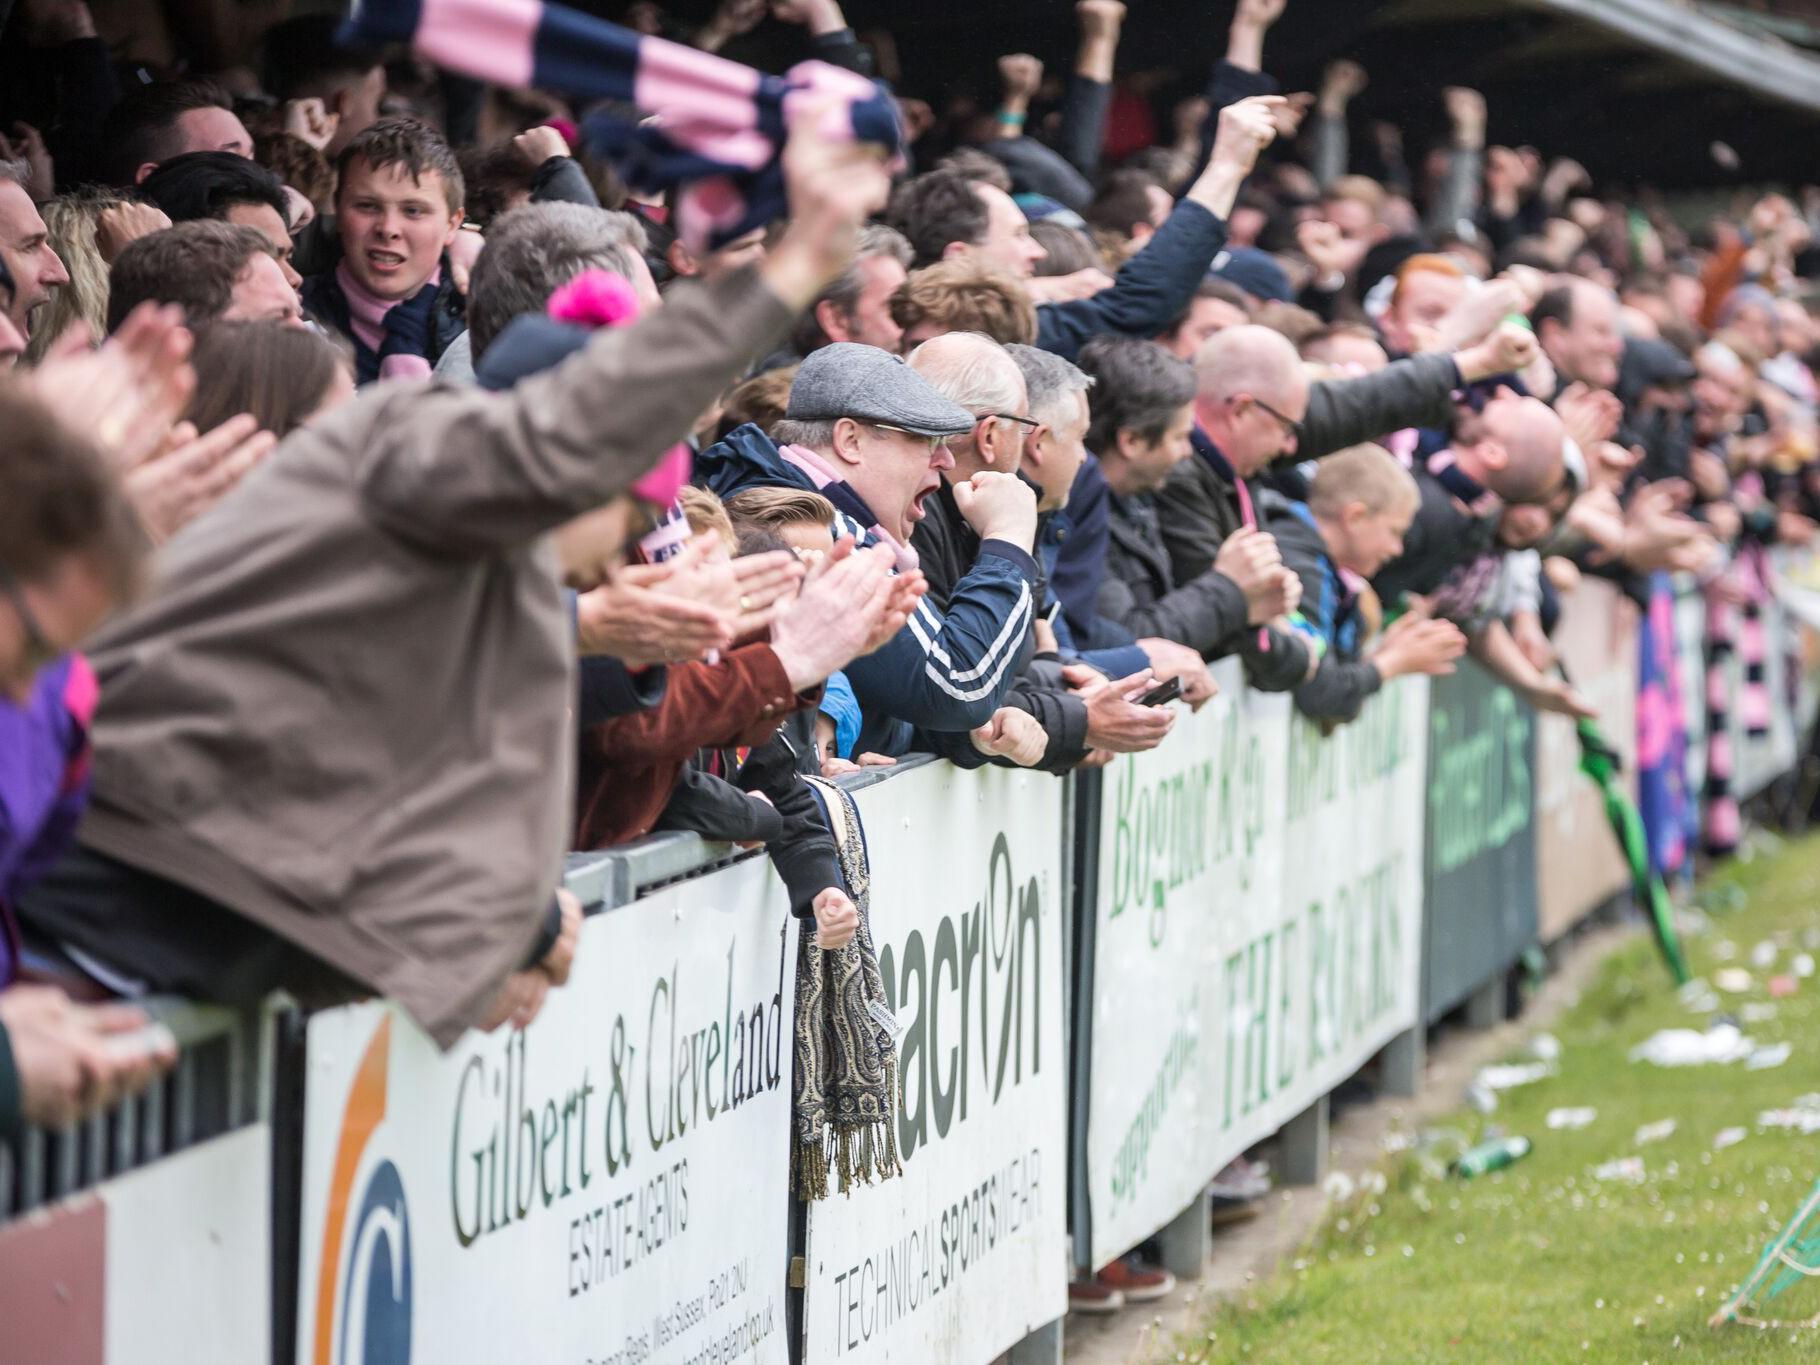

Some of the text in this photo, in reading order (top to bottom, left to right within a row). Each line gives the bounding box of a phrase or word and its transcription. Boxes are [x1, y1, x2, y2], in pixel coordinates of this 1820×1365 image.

[452, 911, 789, 1248] Gilbert & Cleveland
[568, 1157, 689, 1298] ESTATE AGENTS
